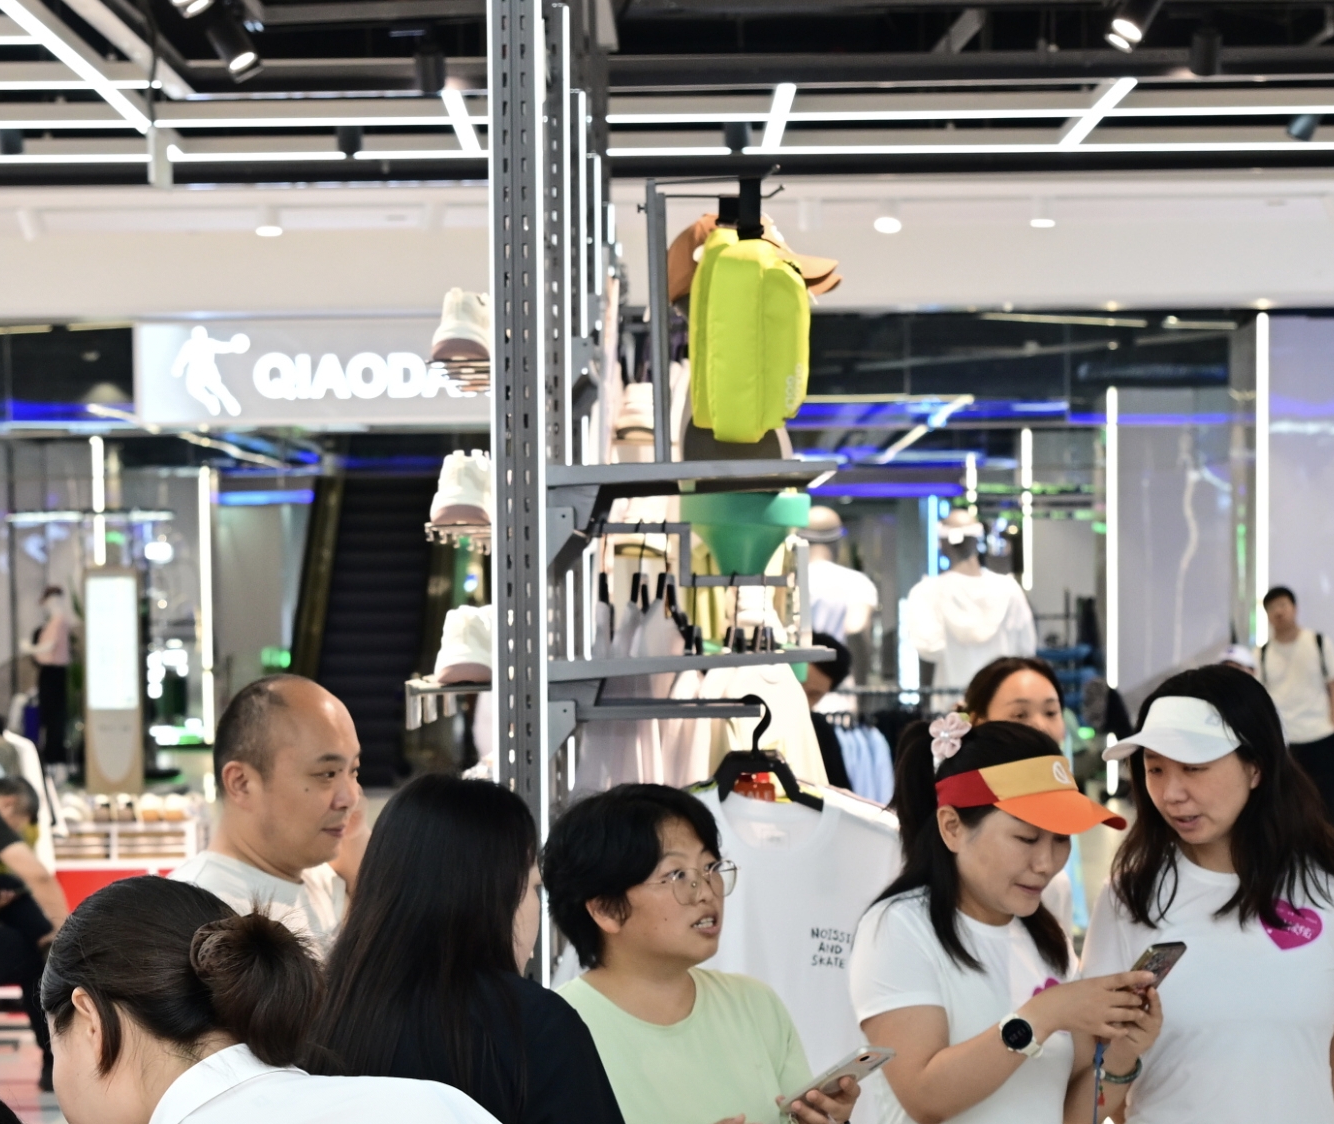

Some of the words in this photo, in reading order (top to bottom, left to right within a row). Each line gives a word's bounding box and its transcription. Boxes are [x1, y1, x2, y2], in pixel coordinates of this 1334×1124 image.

[253, 352, 493, 400] QIAODA
[818, 941, 843, 954] AND
[811, 954, 846, 969] SKATE
